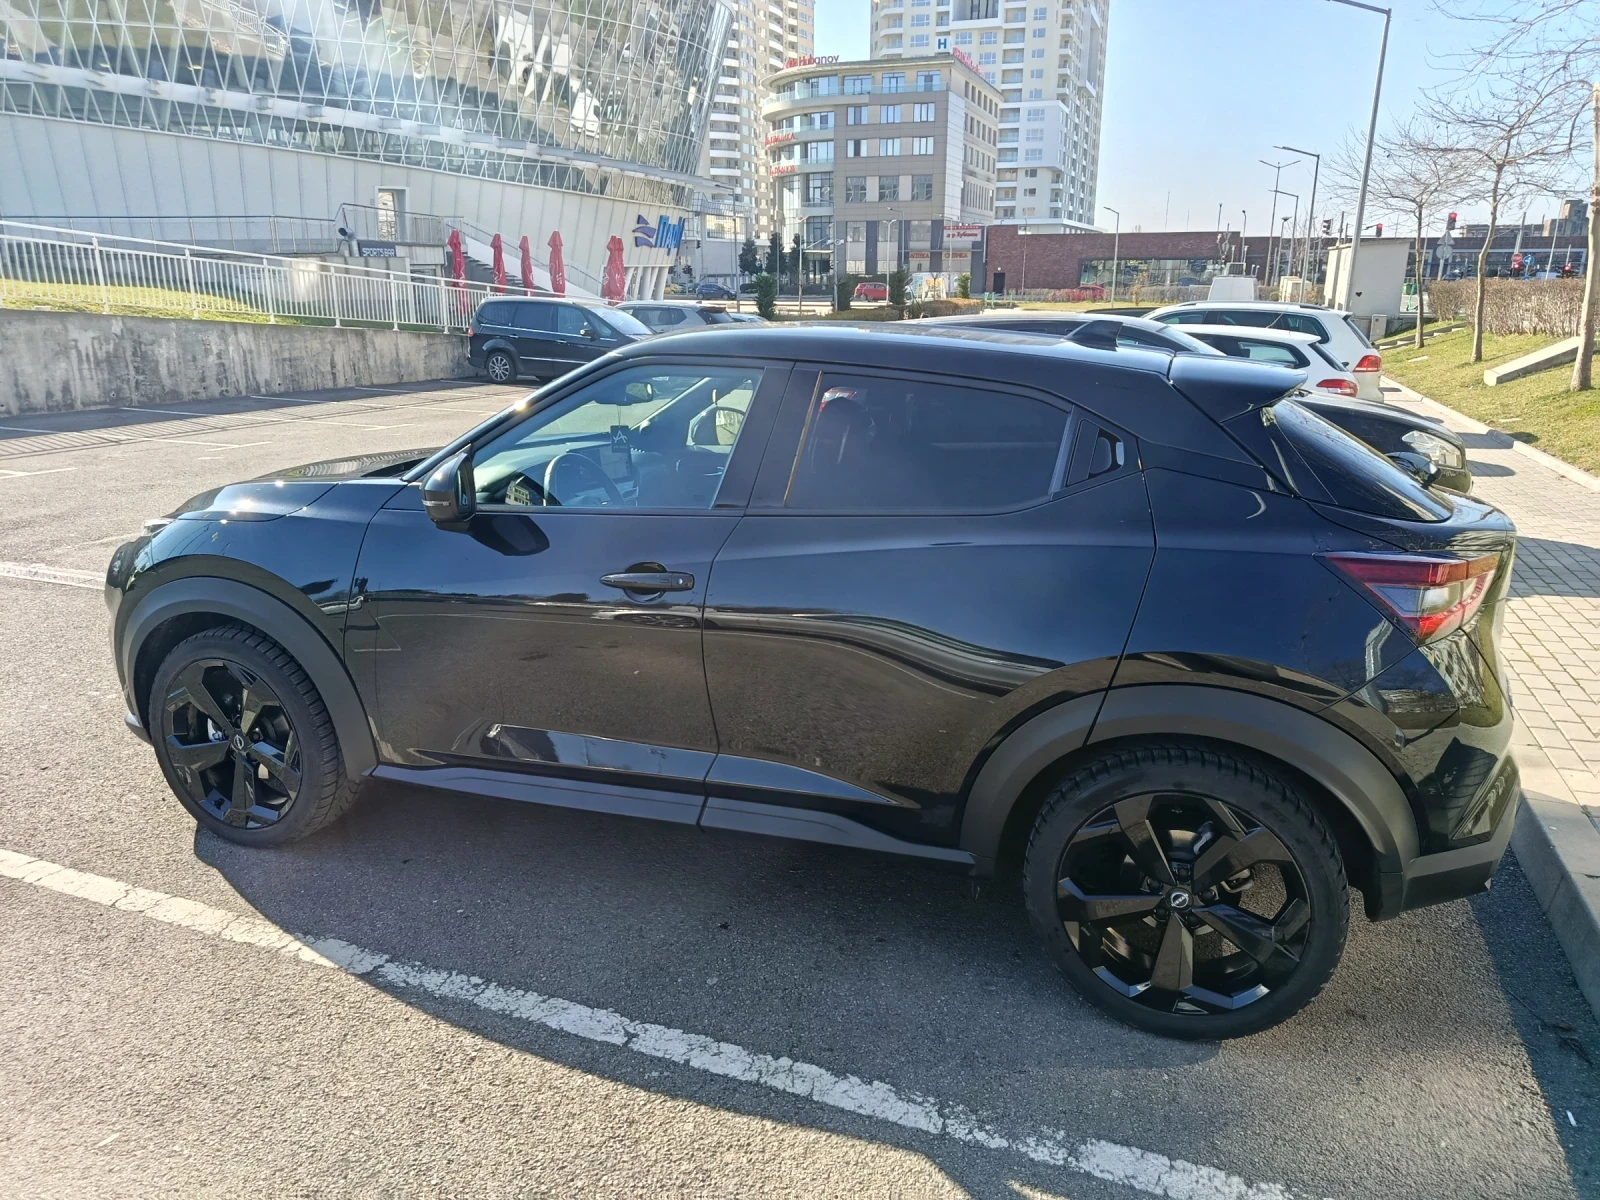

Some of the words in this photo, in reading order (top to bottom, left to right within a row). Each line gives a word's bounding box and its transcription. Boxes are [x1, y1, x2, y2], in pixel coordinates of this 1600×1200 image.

[937, 38, 947, 49] H
[798, 54, 840, 67] Hubanov
[362, 247, 384, 257] SPORTS
[384, 248, 395, 257] BAR
